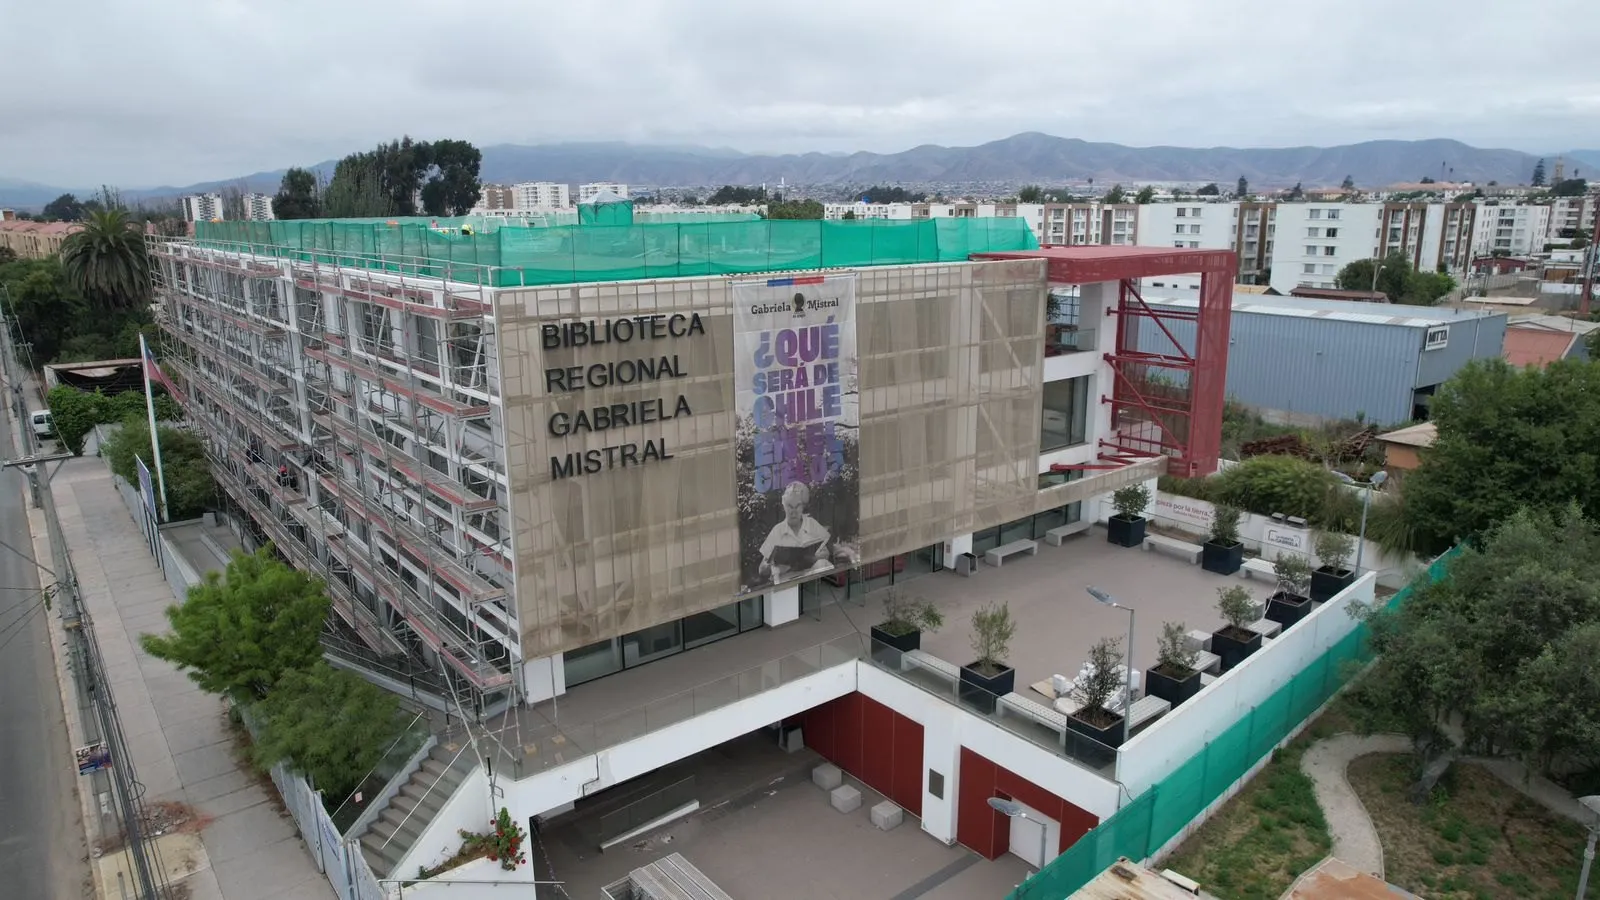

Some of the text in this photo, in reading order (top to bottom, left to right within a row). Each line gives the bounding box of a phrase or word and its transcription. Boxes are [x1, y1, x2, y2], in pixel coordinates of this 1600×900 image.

[751, 298, 839, 315] Gabriela Mistral
[541, 312, 705, 350] BIBLIOTECA
[753, 314, 839, 369] ¿QUÉ
[545, 354, 687, 393] REGIONAL
[752, 362, 840, 395] SERÁ DE
[548, 395, 692, 437] GABRIELA
[753, 384, 842, 431] CHILE
[551, 438, 674, 480] MISTRAL
[1173, 503, 1184, 511] por
